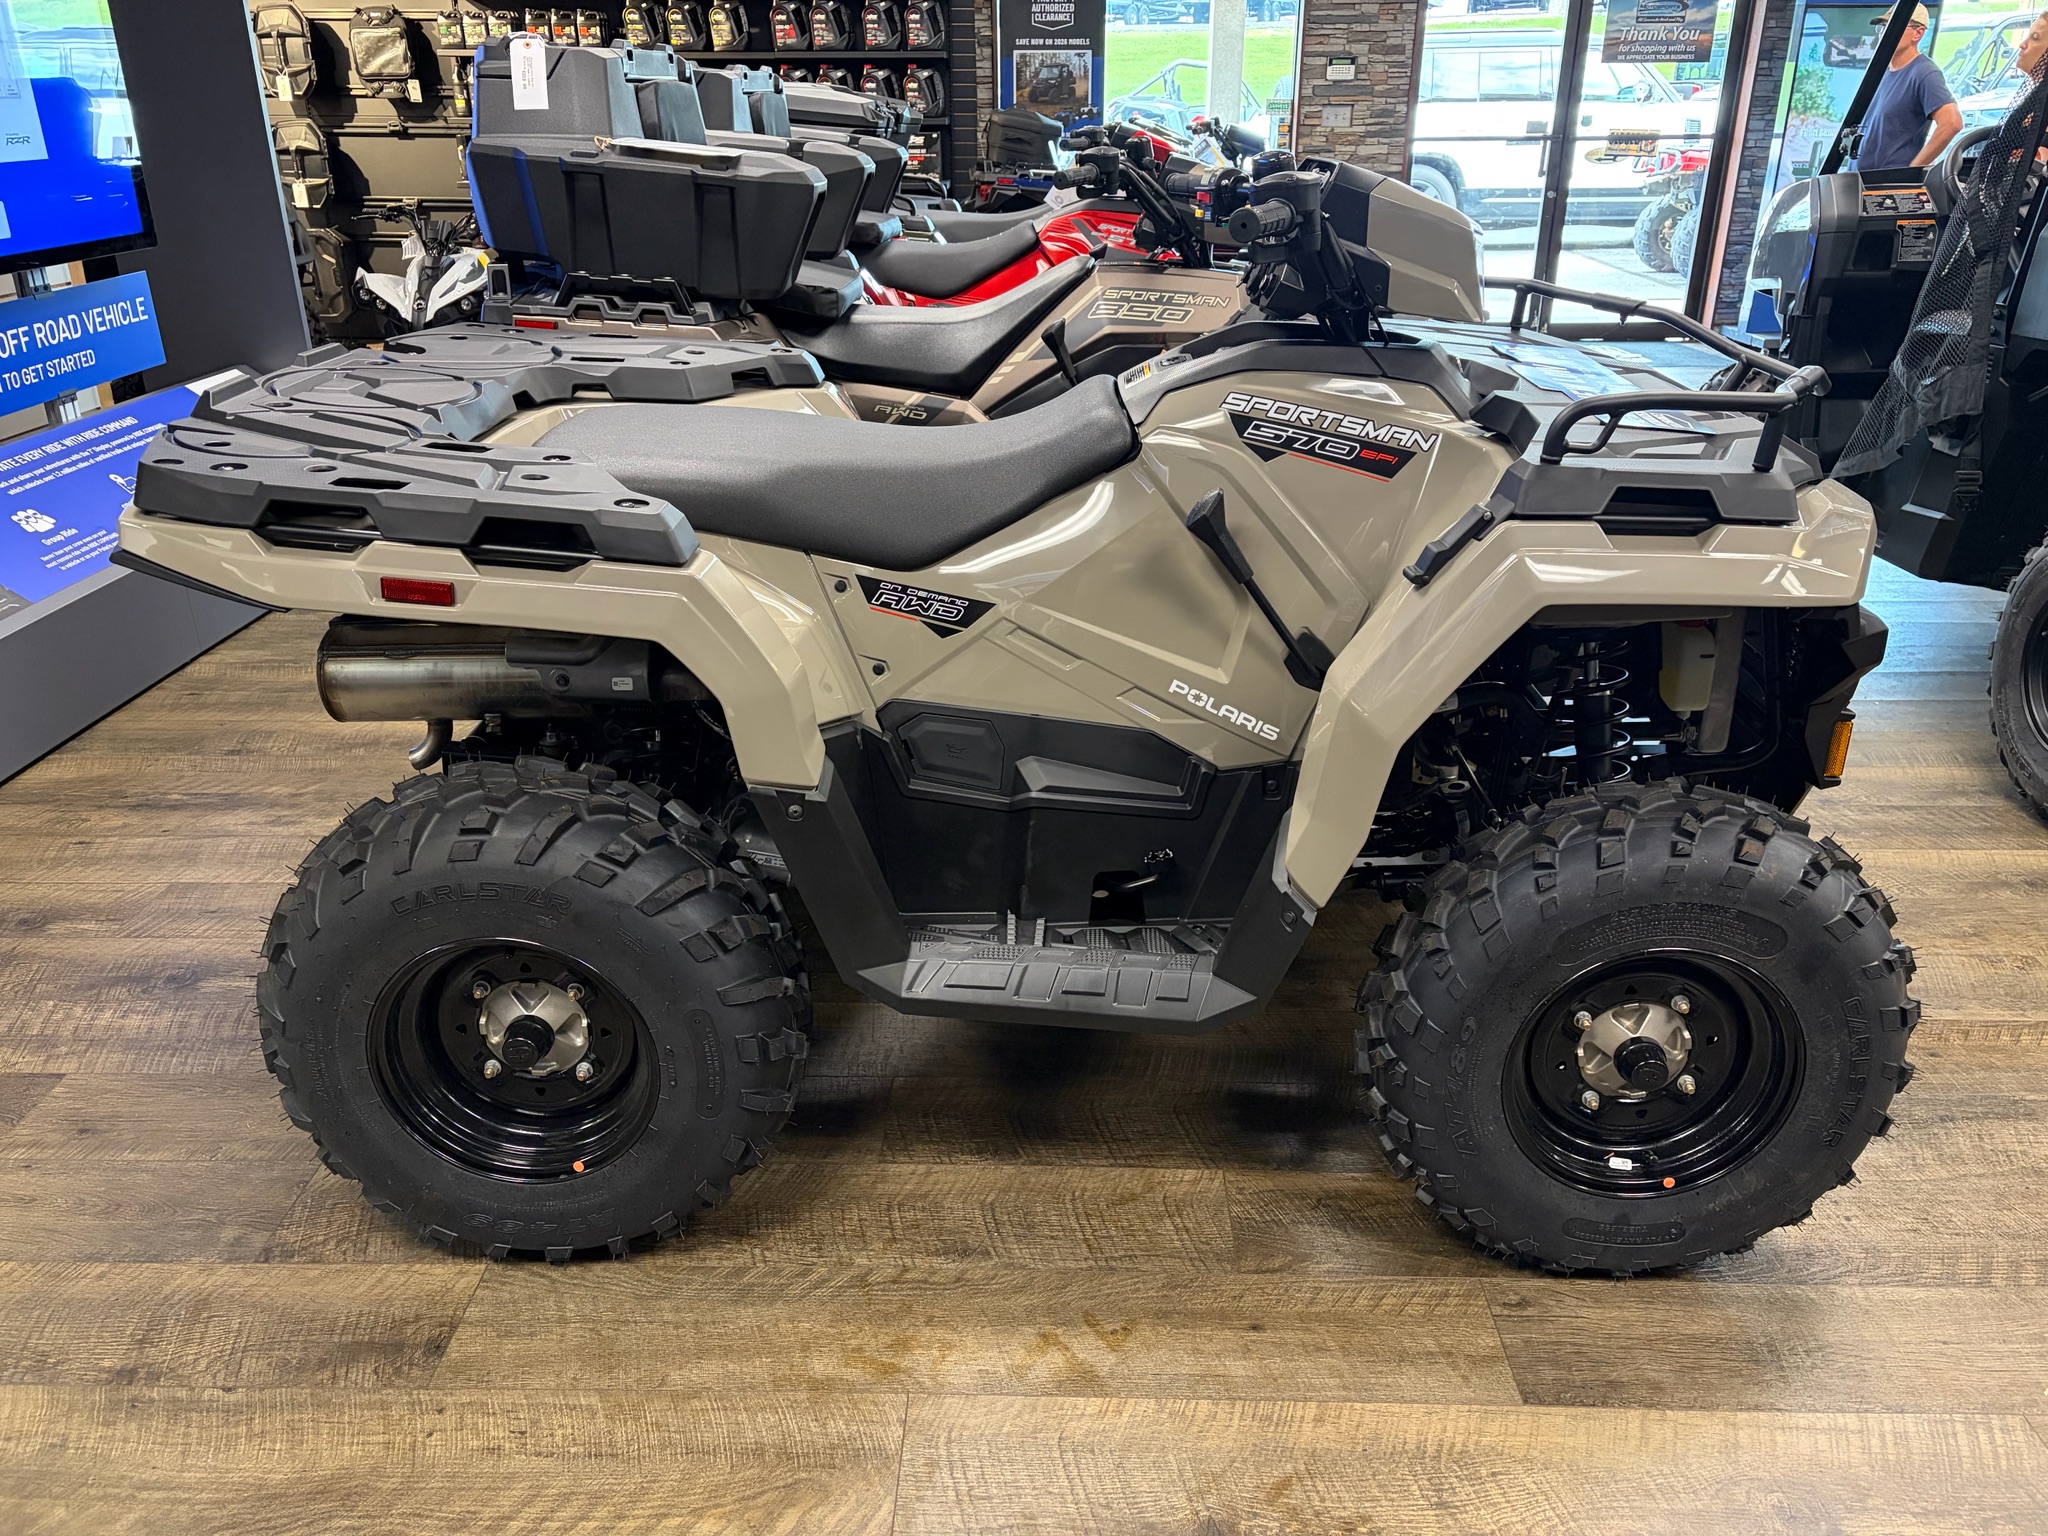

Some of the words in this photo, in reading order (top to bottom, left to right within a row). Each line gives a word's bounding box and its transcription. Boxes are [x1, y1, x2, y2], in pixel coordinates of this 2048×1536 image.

[1031, 3, 1075, 12] AUTHORIZED
[1035, 13, 1071, 21] CLEARANCE
[1620, 26, 1669, 41] Thank
[1672, 26, 1700, 41] You
[1618, 44, 1629, 52] for
[1631, 44, 1668, 54] shopping
[1668, 44, 1685, 52] with
[6, 135, 31, 146] RZR
[1087, 300, 1195, 324] 850
[1102, 289, 1231, 308] SPORTSMAN
[0, 326, 30, 359] OFF
[33, 313, 82, 349] ROAD
[82, 296, 149, 335] VEHICLE
[2, 371, 21, 391] TO
[21, 363, 45, 385] GET
[45, 349, 96, 378] STARTED
[873, 404, 928, 420] AWD
[1218, 390, 1442, 452] SPORTSMAN
[13, 447, 47, 464] EVERY
[40, 441, 67, 454] RIDE
[59, 433, 87, 447] WITH
[80, 428, 105, 440] RIDE
[98, 416, 139, 434] COMMAND
[1243, 420, 1360, 460] 570
[1359, 449, 1399, 465] EFI
[41, 534, 65, 546] Group
[59, 528, 79, 538] Ride
[871, 589, 965, 621] AWD
[879, 581, 902, 592] ON
[906, 588, 970, 607] DEMAND
[1168, 679, 1280, 741] POLARIS
[390, 880, 573, 917] CARLSTAR
[1444, 1016, 1479, 1155] AT489
[1823, 996, 1871, 1150] CARLSTAR
[461, 1207, 615, 1236] AT489
